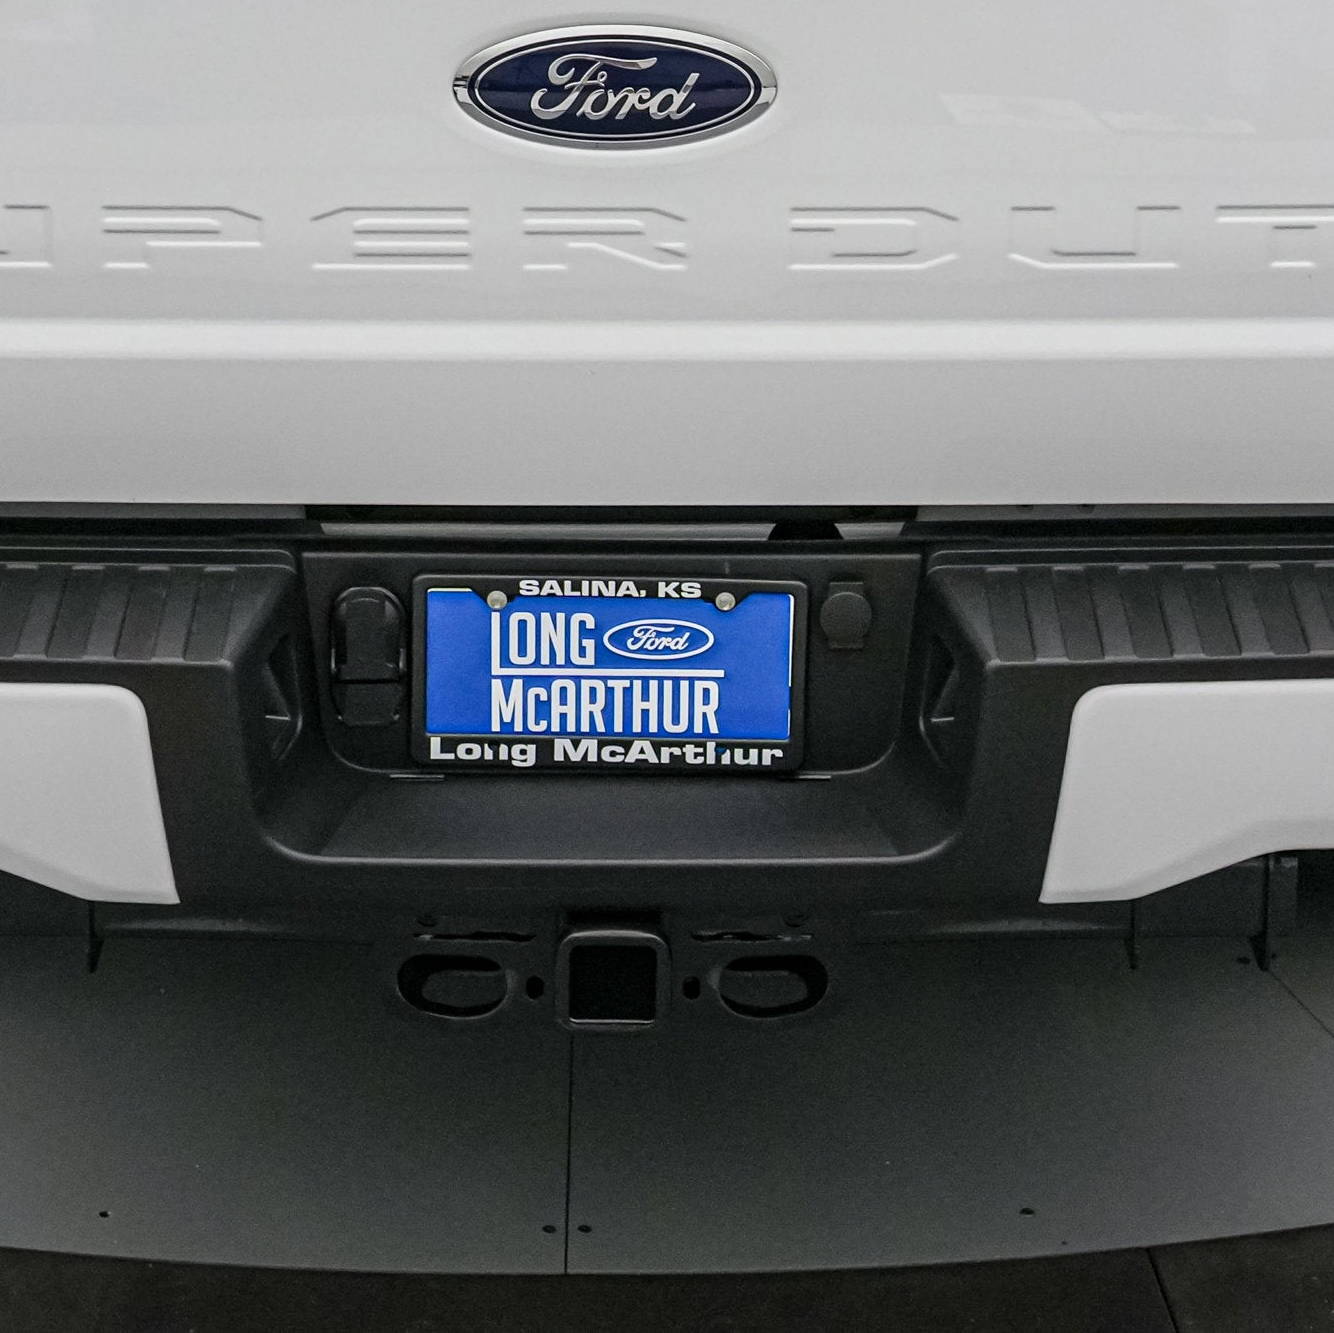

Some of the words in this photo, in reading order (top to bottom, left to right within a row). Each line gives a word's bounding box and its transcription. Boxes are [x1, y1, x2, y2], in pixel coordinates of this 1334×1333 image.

[529, 53, 700, 120] Ford
[519, 579, 646, 599] SALINA,
[658, 582, 702, 598] KS
[491, 612, 595, 675] LONG
[627, 625, 689, 651] Ford
[430, 737, 536, 766] Long
[554, 739, 784, 765] McArthur
